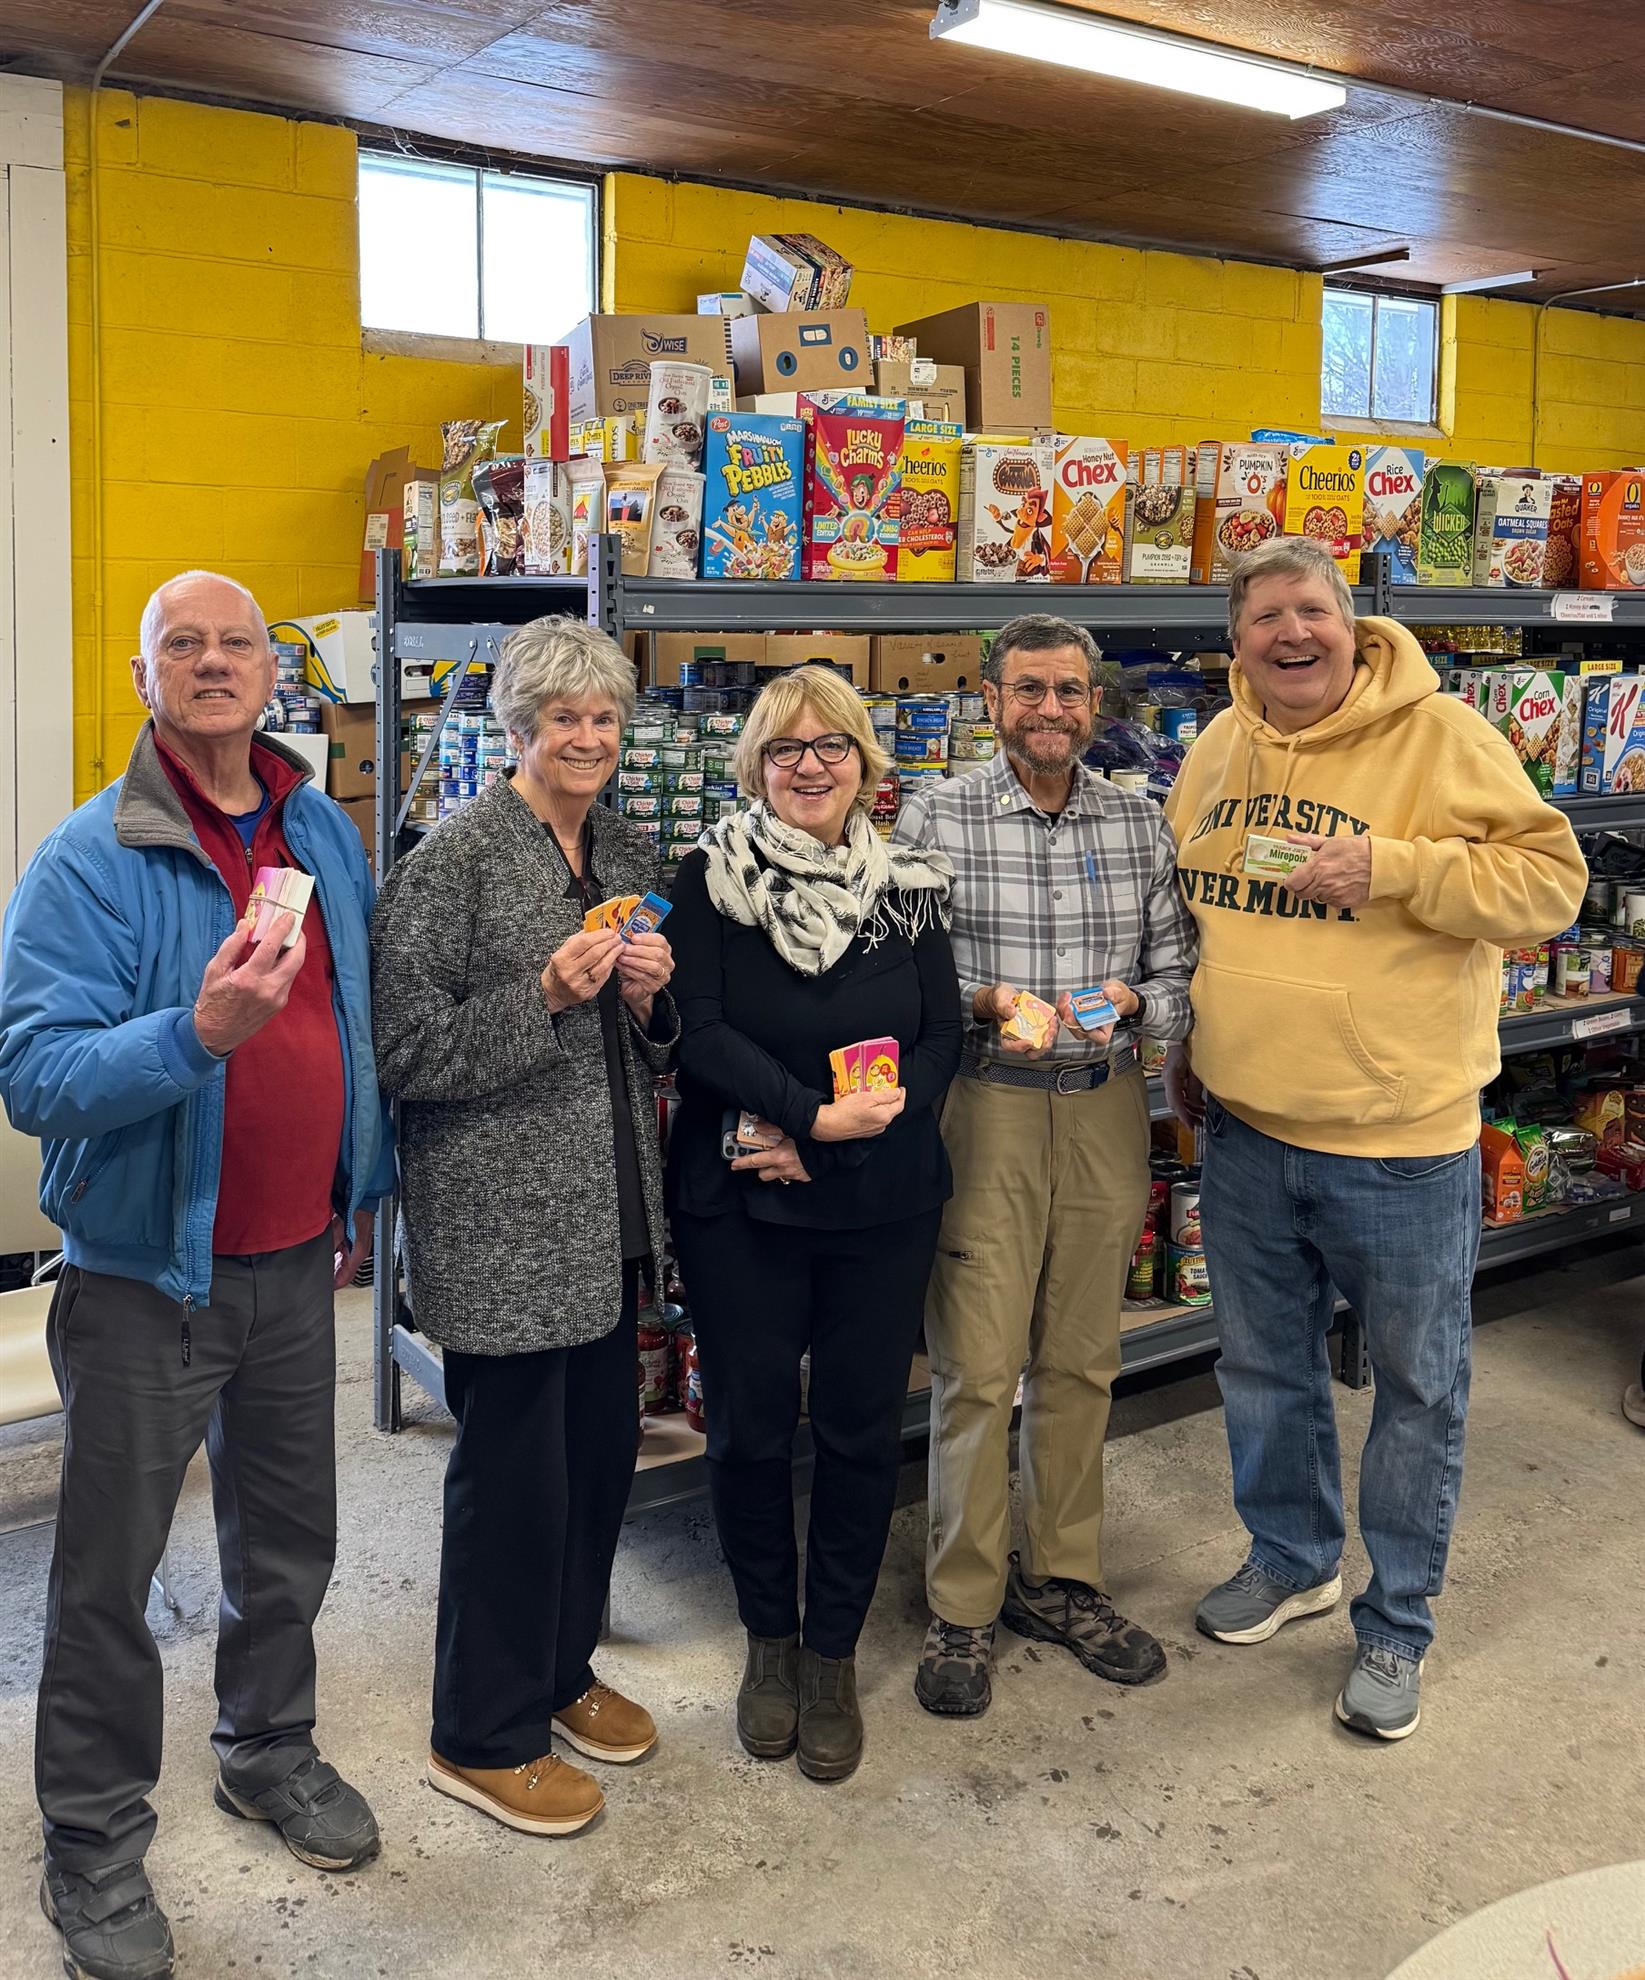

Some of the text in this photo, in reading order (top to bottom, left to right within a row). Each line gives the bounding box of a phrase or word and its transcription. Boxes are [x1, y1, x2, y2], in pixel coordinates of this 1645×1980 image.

[663, 339, 685, 352] WISE
[1011, 335, 1022, 399] 14 PIECES
[612, 371, 634, 381] DEEP
[847, 396, 900, 411] FAMILY SIZE
[712, 419, 728, 430] Post
[910, 423, 957, 436] LARGE SIZE
[726, 430, 782, 446] MARSHMALLOW
[1082, 452, 1114, 464] Honey Nut
[1239, 459, 1274, 472] PUMPKIN
[1062, 459, 1118, 489] Chex
[1386, 463, 1404, 476] Rice
[720, 460, 792, 497] PEBBLES
[1299, 465, 1356, 492] Cheerios
[1368, 471, 1415, 497] Chex
[1515, 503, 1538, 513] QUAKER
[1550, 498, 1580, 519] asted
[1433, 511, 1466, 534] WICKED
[1498, 517, 1548, 529] OATMEAL SQUARES
[1553, 517, 1574, 532] Oats
[907, 533, 944, 543] CHOLESTEROL
[1587, 663, 1617, 672] LARGE SIZE
[1496, 683, 1507, 713] Chex
[1534, 689, 1551, 701] Corn
[1519, 697, 1557, 722] Chex
[1588, 706, 1608, 714] Original
[1188, 793, 1370, 844] UNIVERSITY
[1269, 848, 1308, 863] Mirepoix
